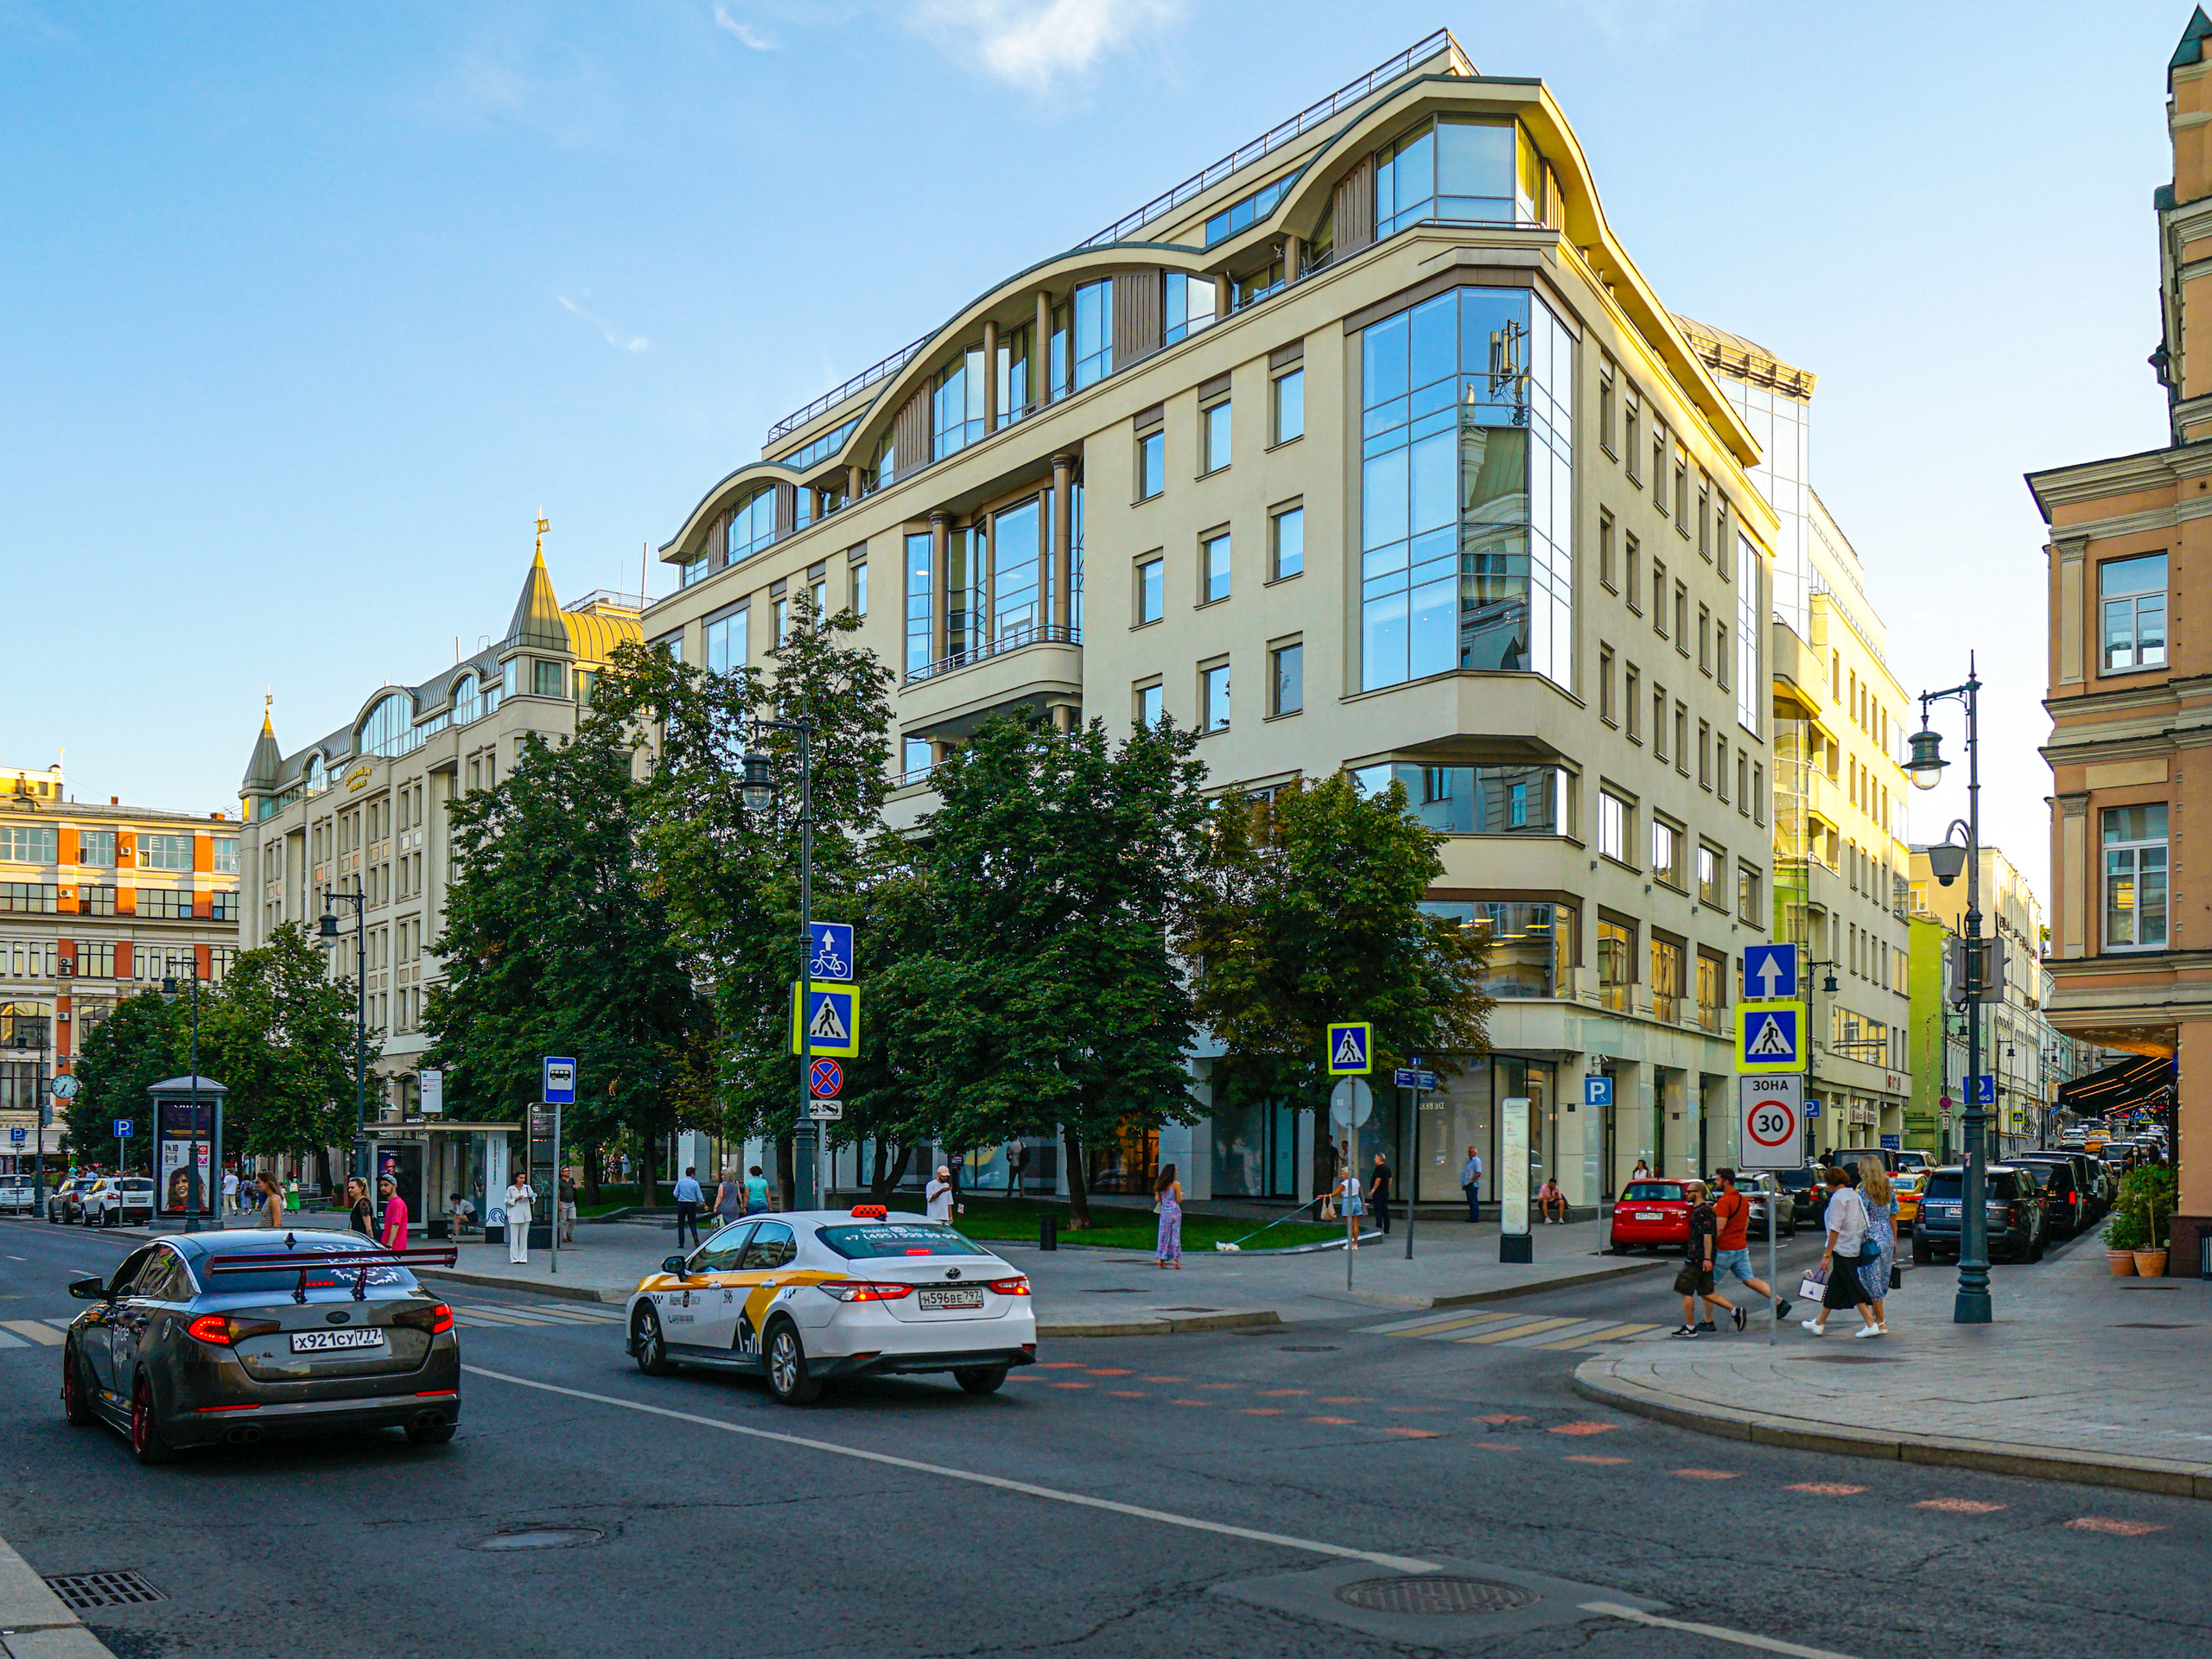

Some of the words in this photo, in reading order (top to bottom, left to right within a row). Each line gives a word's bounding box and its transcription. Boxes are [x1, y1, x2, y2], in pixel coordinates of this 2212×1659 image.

[1752, 1080, 1789, 1091] ЗОНА
[1758, 1115, 1783, 1133] 30
[924, 1292, 963, 1305] Н596ВЕ
[963, 1291, 979, 1300] 797
[298, 1333, 354, 1349] Х921СУ
[357, 1329, 378, 1340] 777
